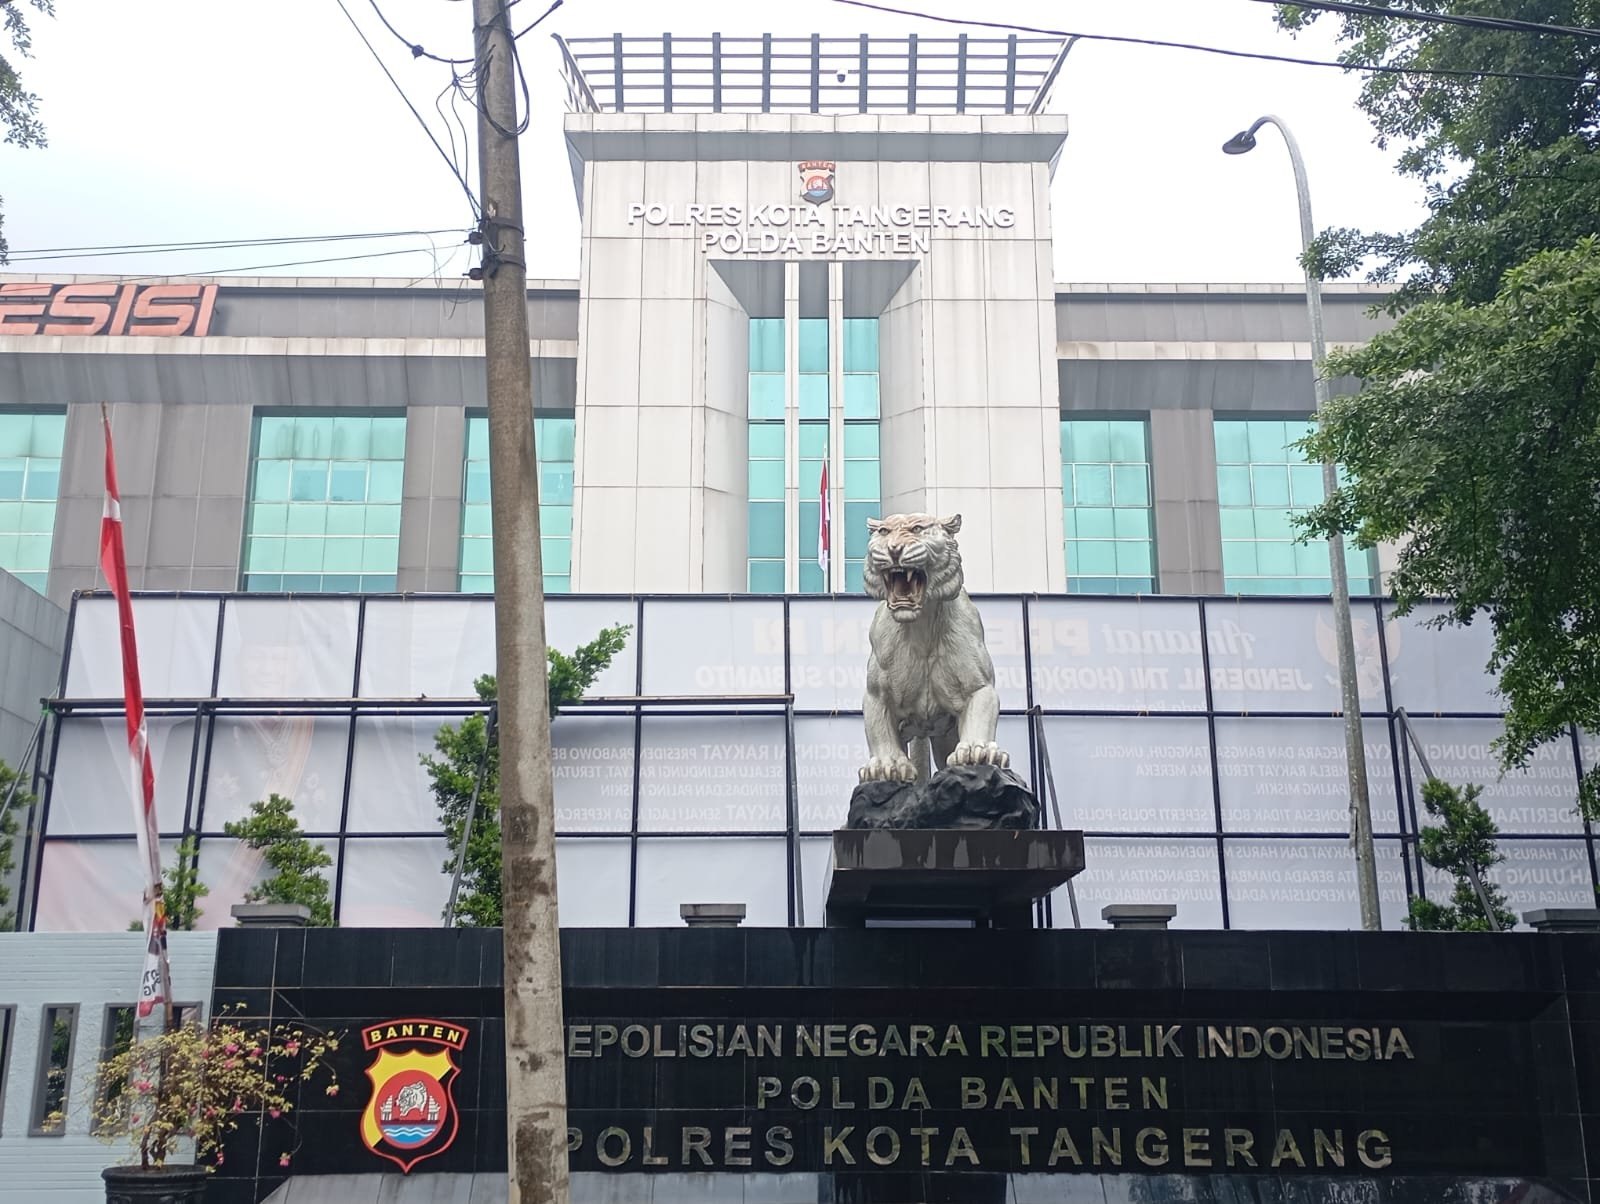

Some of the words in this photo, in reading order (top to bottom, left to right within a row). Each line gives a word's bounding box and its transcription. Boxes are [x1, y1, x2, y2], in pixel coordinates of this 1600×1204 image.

[627, 203, 742, 227] POLRES
[749, 203, 826, 227] KOTA
[833, 204, 1015, 228] TANGERANG
[702, 231, 803, 254] POLDA
[811, 231, 931, 254] BANTEN
[370, 1024, 460, 1043] BANTEN
[567, 1023, 783, 1058] EPOLISIAN
[795, 1023, 969, 1058] NEGARA
[980, 1024, 1184, 1058] REPUBLIK
[1196, 1025, 1415, 1061] INDONESIA
[756, 1075, 932, 1110] POLDA
[960, 1076, 1169, 1110] BANTEN
[823, 1125, 981, 1166] KOTA
[1009, 1126, 1393, 1169] TANGERANG
